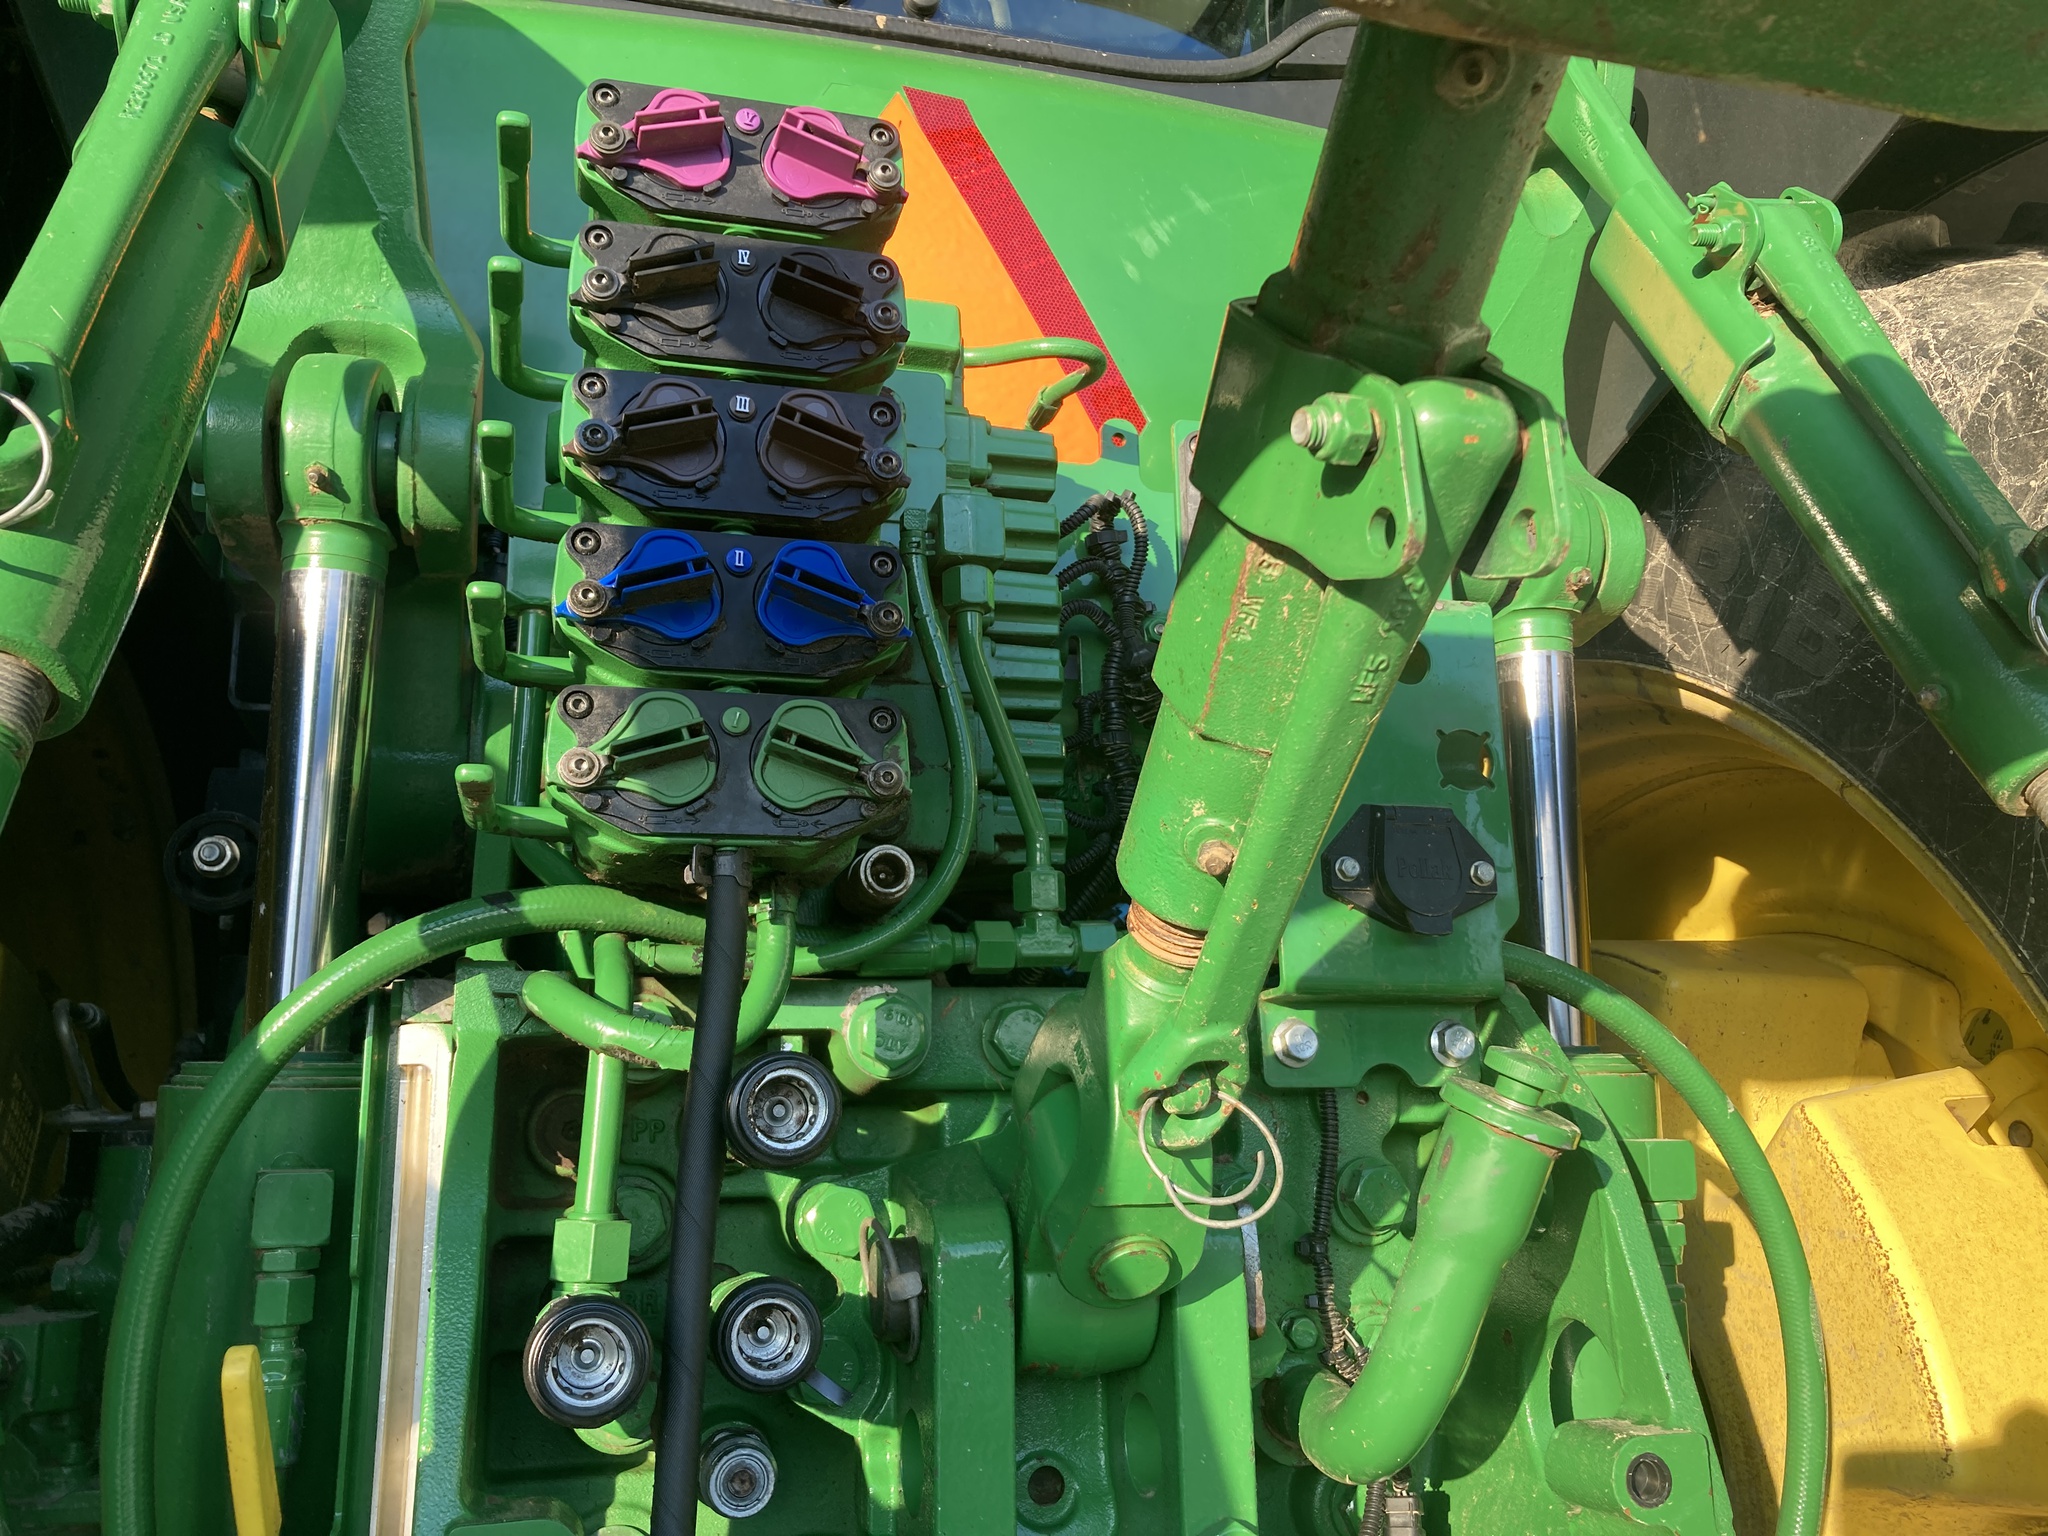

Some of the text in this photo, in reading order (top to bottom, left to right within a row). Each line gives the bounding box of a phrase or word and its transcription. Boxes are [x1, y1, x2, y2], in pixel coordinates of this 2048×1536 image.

[737, 249, 751, 266] IV
[735, 395, 751, 413] III
[734, 549, 745, 567] II
[1395, 856, 1455, 880] Pollak
[631, 1118, 666, 1145] PP
